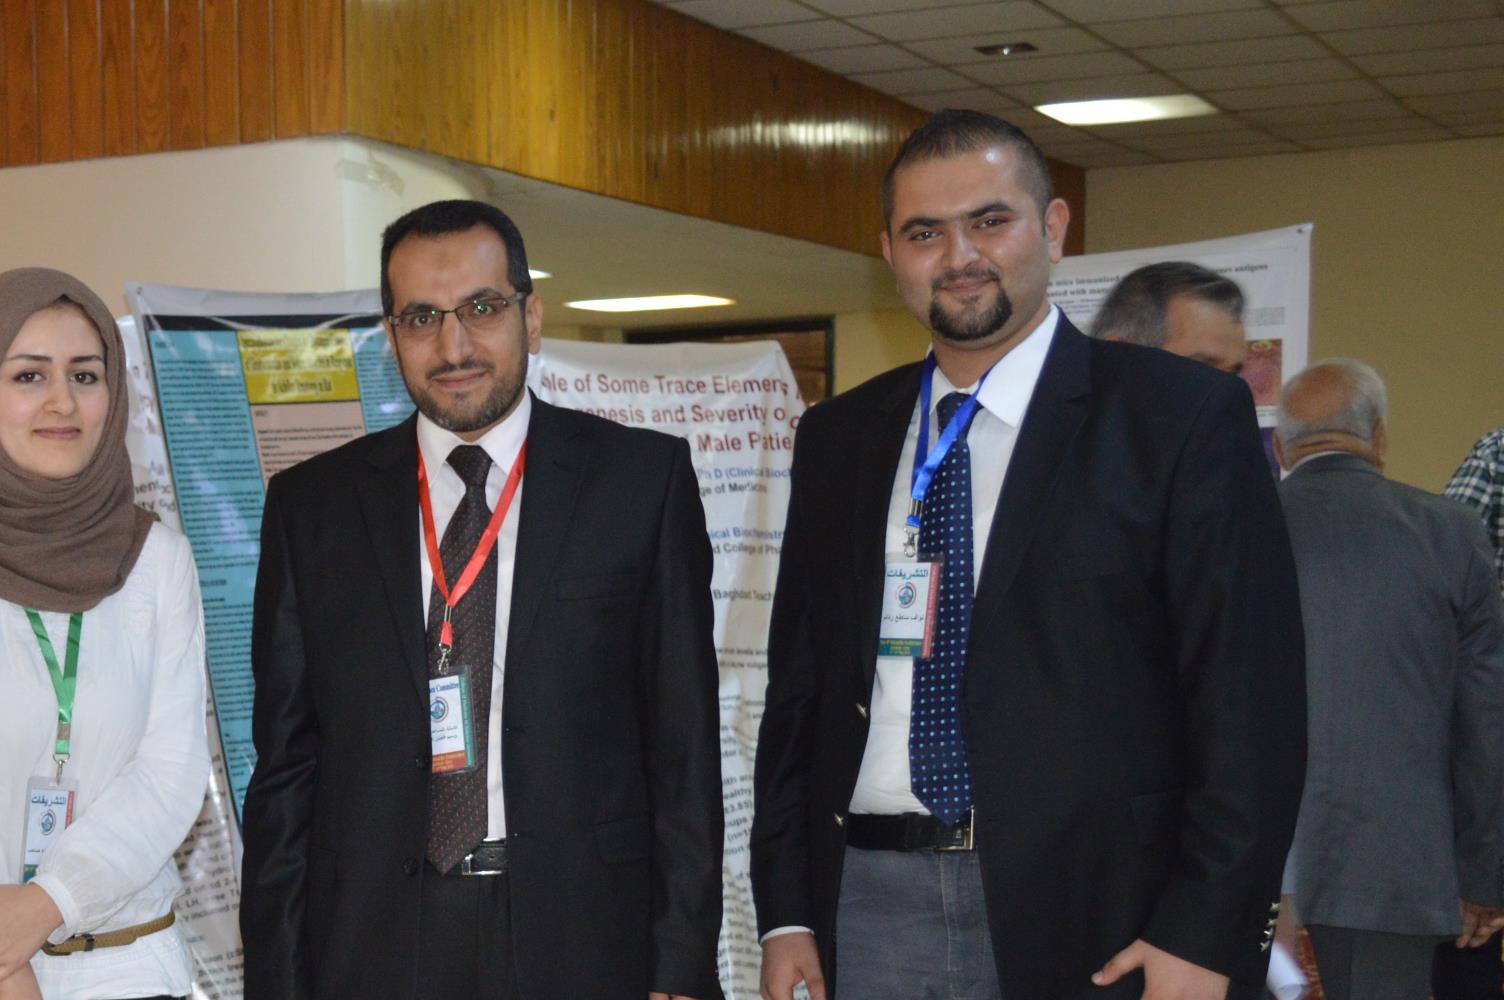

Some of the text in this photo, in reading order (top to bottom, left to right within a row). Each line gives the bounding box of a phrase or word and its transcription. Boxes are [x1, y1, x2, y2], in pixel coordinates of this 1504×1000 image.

[575, 373, 592, 393] of
[597, 373, 650, 393] Some
[653, 375, 706, 393] Trace
[651, 408, 686, 423] and
[691, 404, 769, 426] Severity
[697, 433, 742, 452] Male
[714, 483, 726, 495] of
[886, 567, 929, 580] التشريفات
